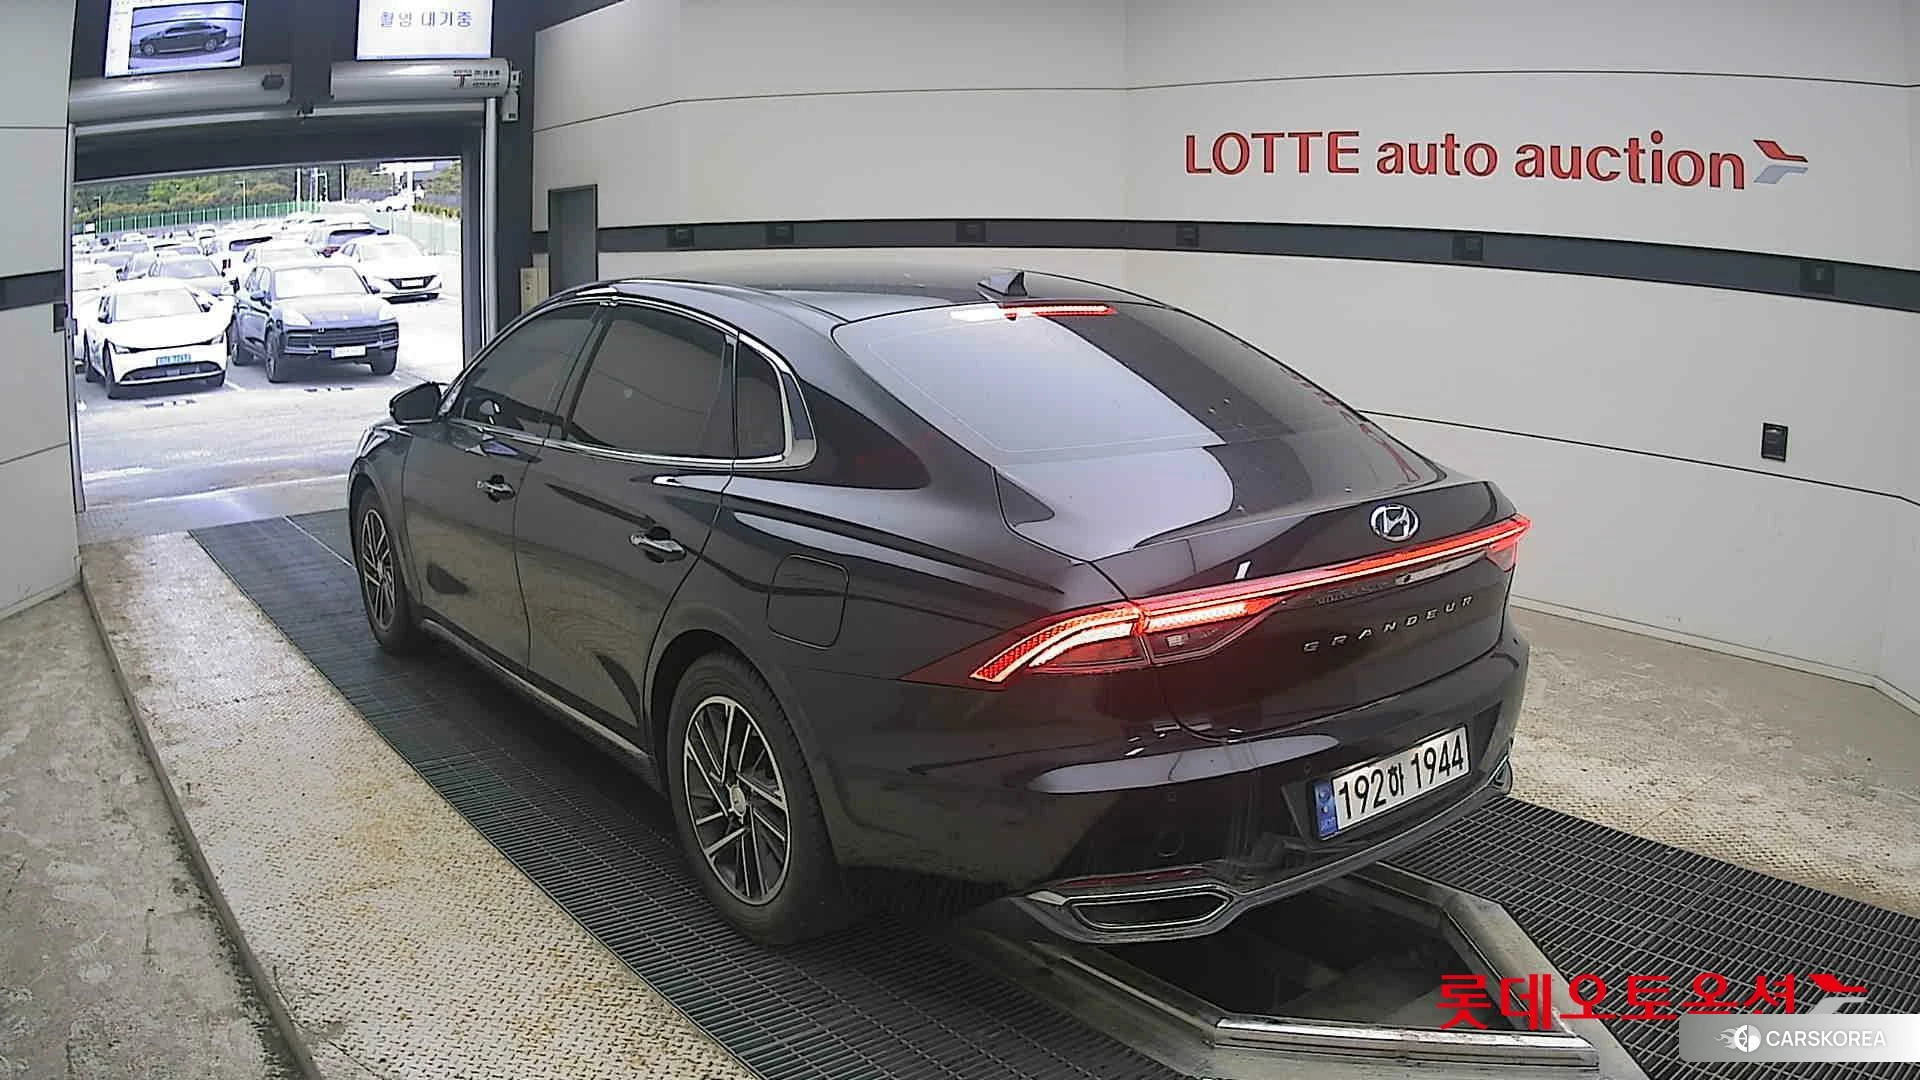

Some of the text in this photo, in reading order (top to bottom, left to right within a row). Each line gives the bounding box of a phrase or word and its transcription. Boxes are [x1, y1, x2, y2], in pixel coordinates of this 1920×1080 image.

[421, 11, 472, 28] 대기중
[1185, 130, 1745, 190] LOTTE auto auction
[1303, 595, 1474, 652] GRANDEUR
[1338, 735, 1464, 819] 192하 1944
